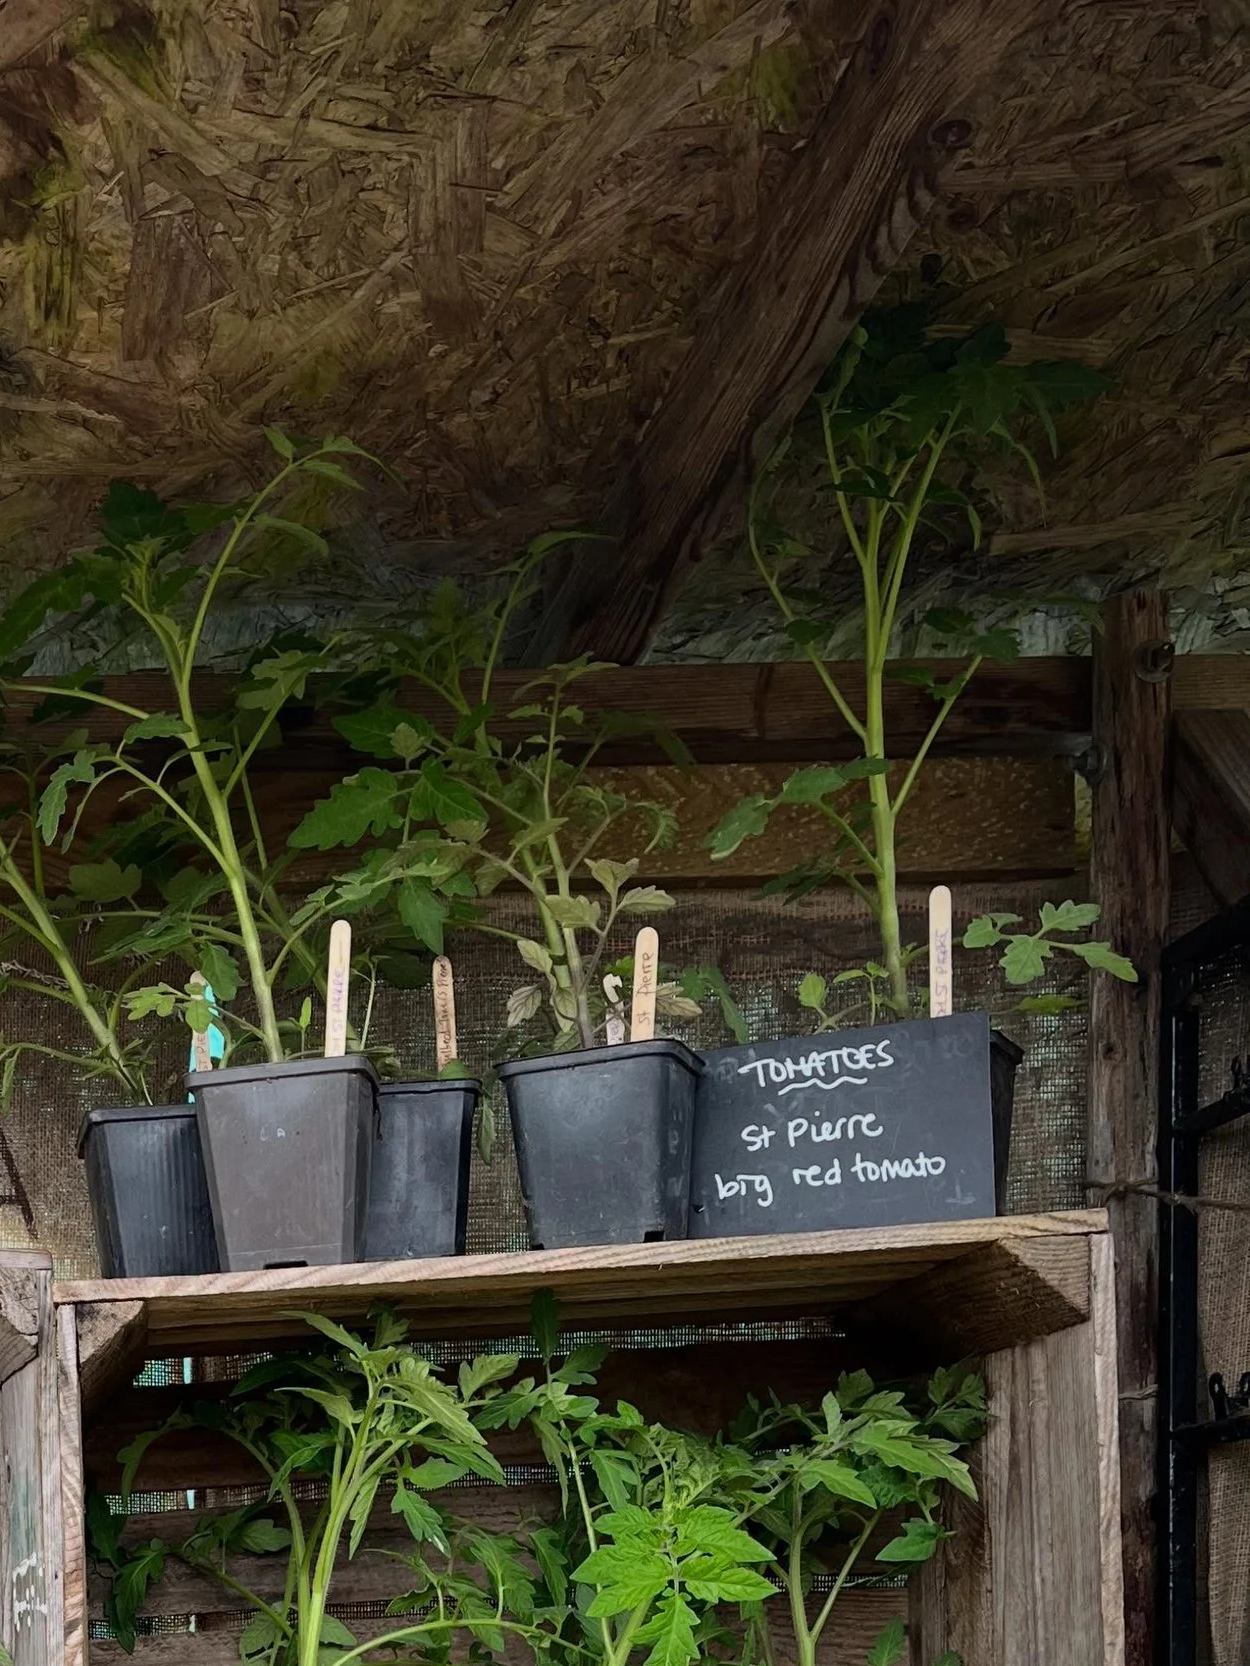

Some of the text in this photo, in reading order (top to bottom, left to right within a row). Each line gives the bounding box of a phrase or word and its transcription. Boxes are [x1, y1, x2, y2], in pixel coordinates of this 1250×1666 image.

[737, 1038, 895, 1087] TOMATOES
[714, 1151, 947, 1208] big red tomato
